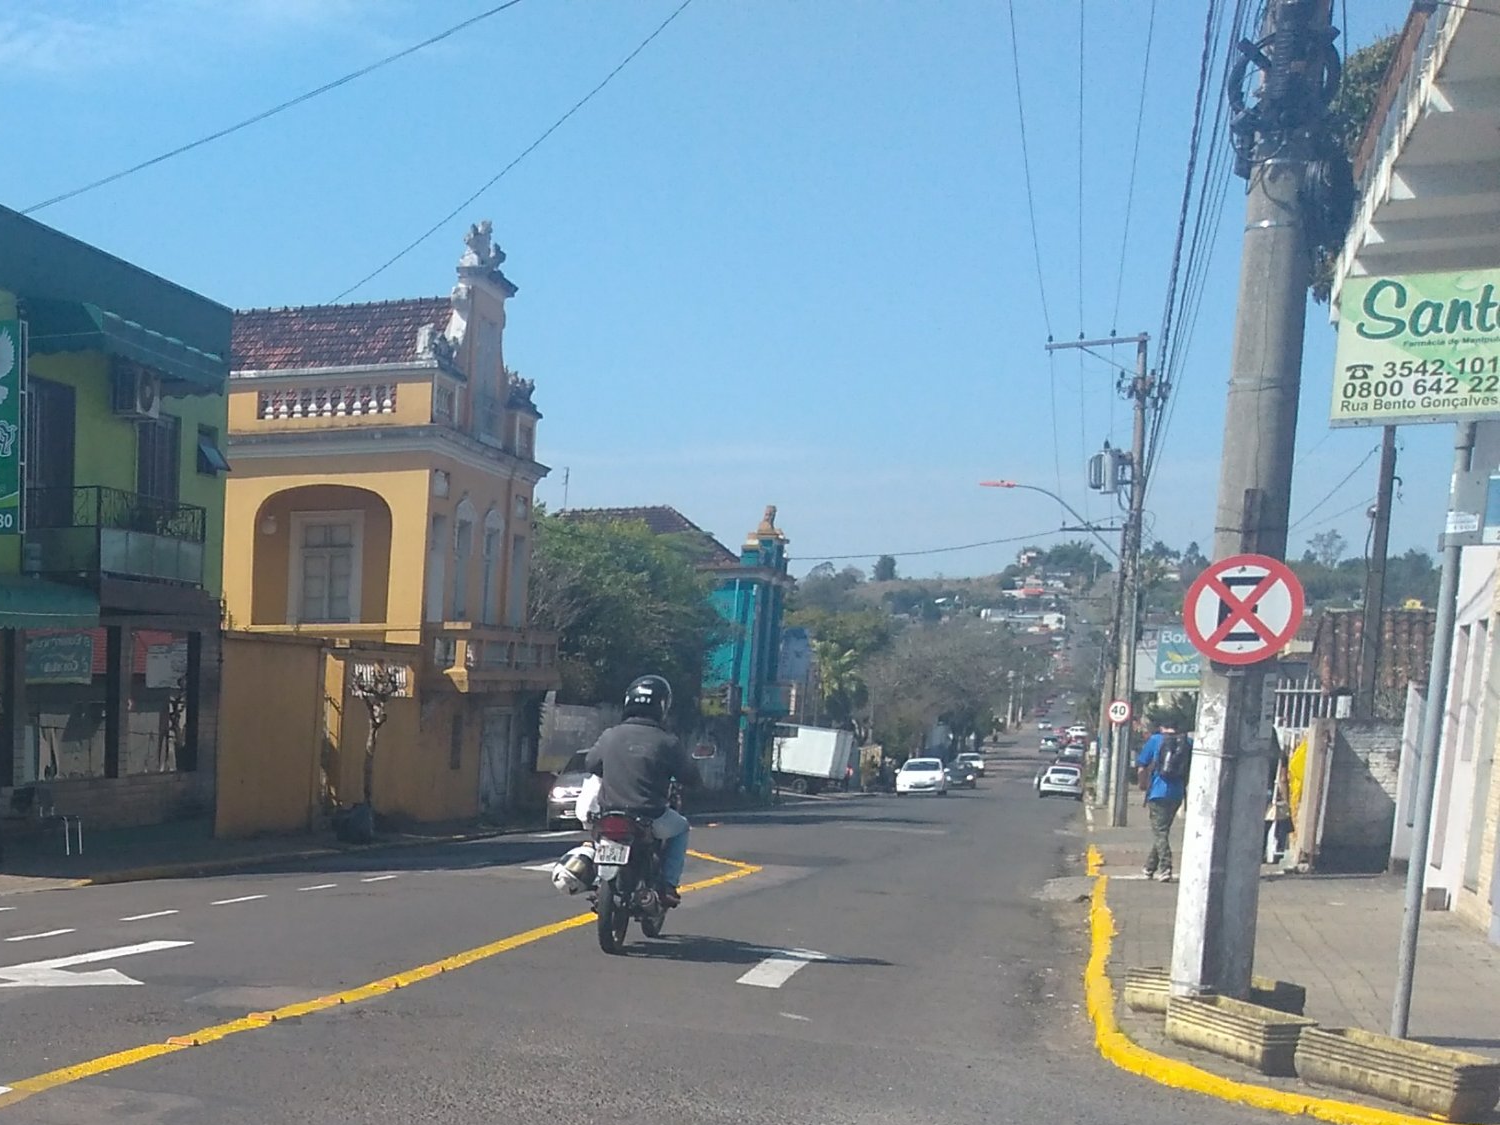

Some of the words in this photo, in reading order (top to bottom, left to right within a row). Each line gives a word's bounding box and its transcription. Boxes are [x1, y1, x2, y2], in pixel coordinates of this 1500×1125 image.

[1356, 278, 1500, 340] Sant
[1448, 337, 1460, 346] de
[1343, 380, 1404, 399] 0800
[1412, 376, 1460, 396] 642
[1340, 400, 1369, 412] Rua
[1373, 398, 1417, 412] Bento
[1420, 394, 1499, 409] Gonçalves
[1111, 705, 1126, 716] 40
